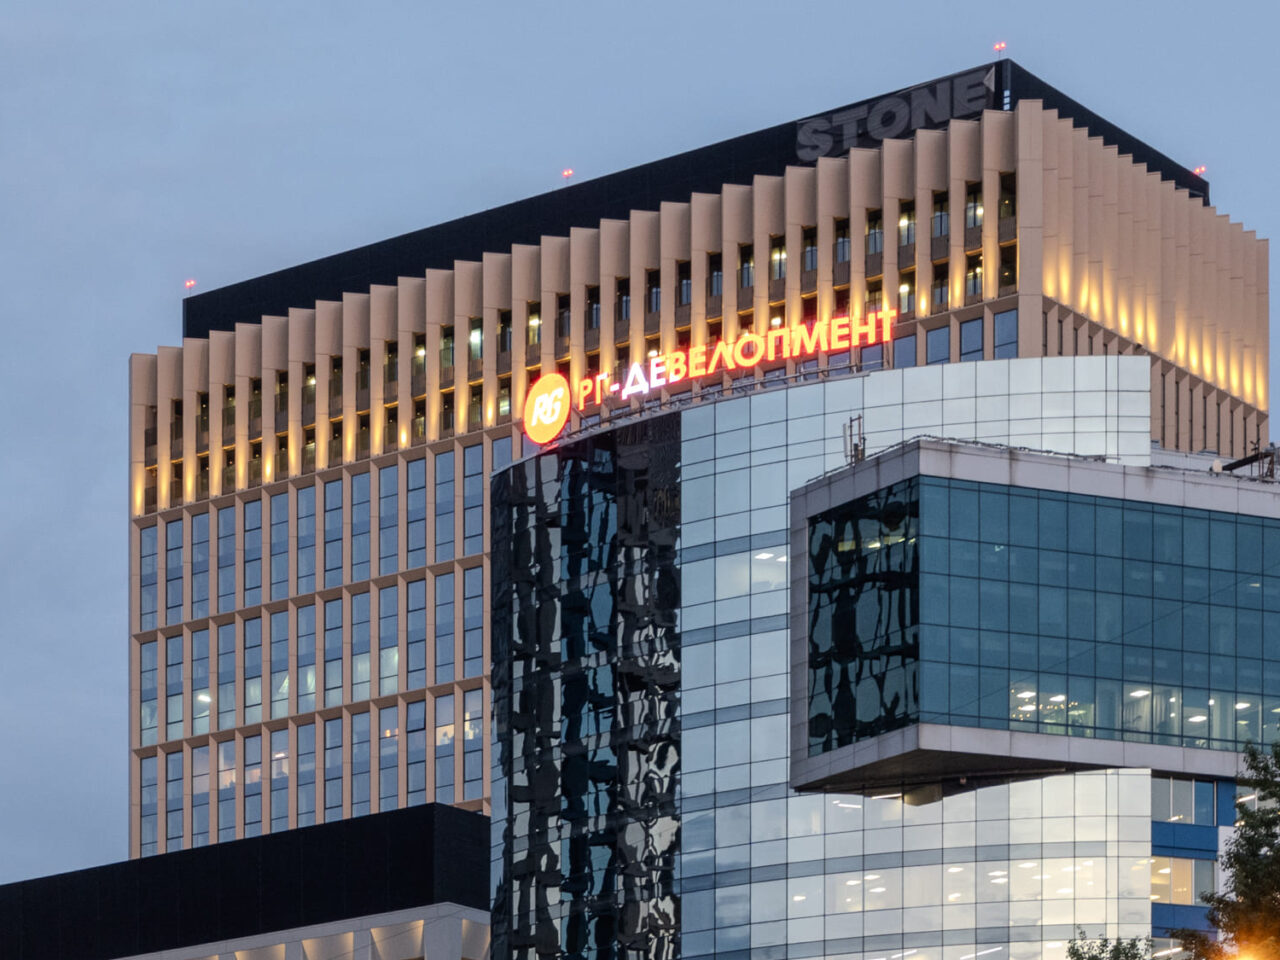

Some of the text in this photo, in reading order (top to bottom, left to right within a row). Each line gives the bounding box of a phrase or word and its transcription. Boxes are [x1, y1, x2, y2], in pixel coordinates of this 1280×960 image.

[796, 69, 990, 162] STONE
[578, 309, 897, 411] РГ-ДЕВЕЛОПМЕНТ
[530, 387, 565, 427] RG
